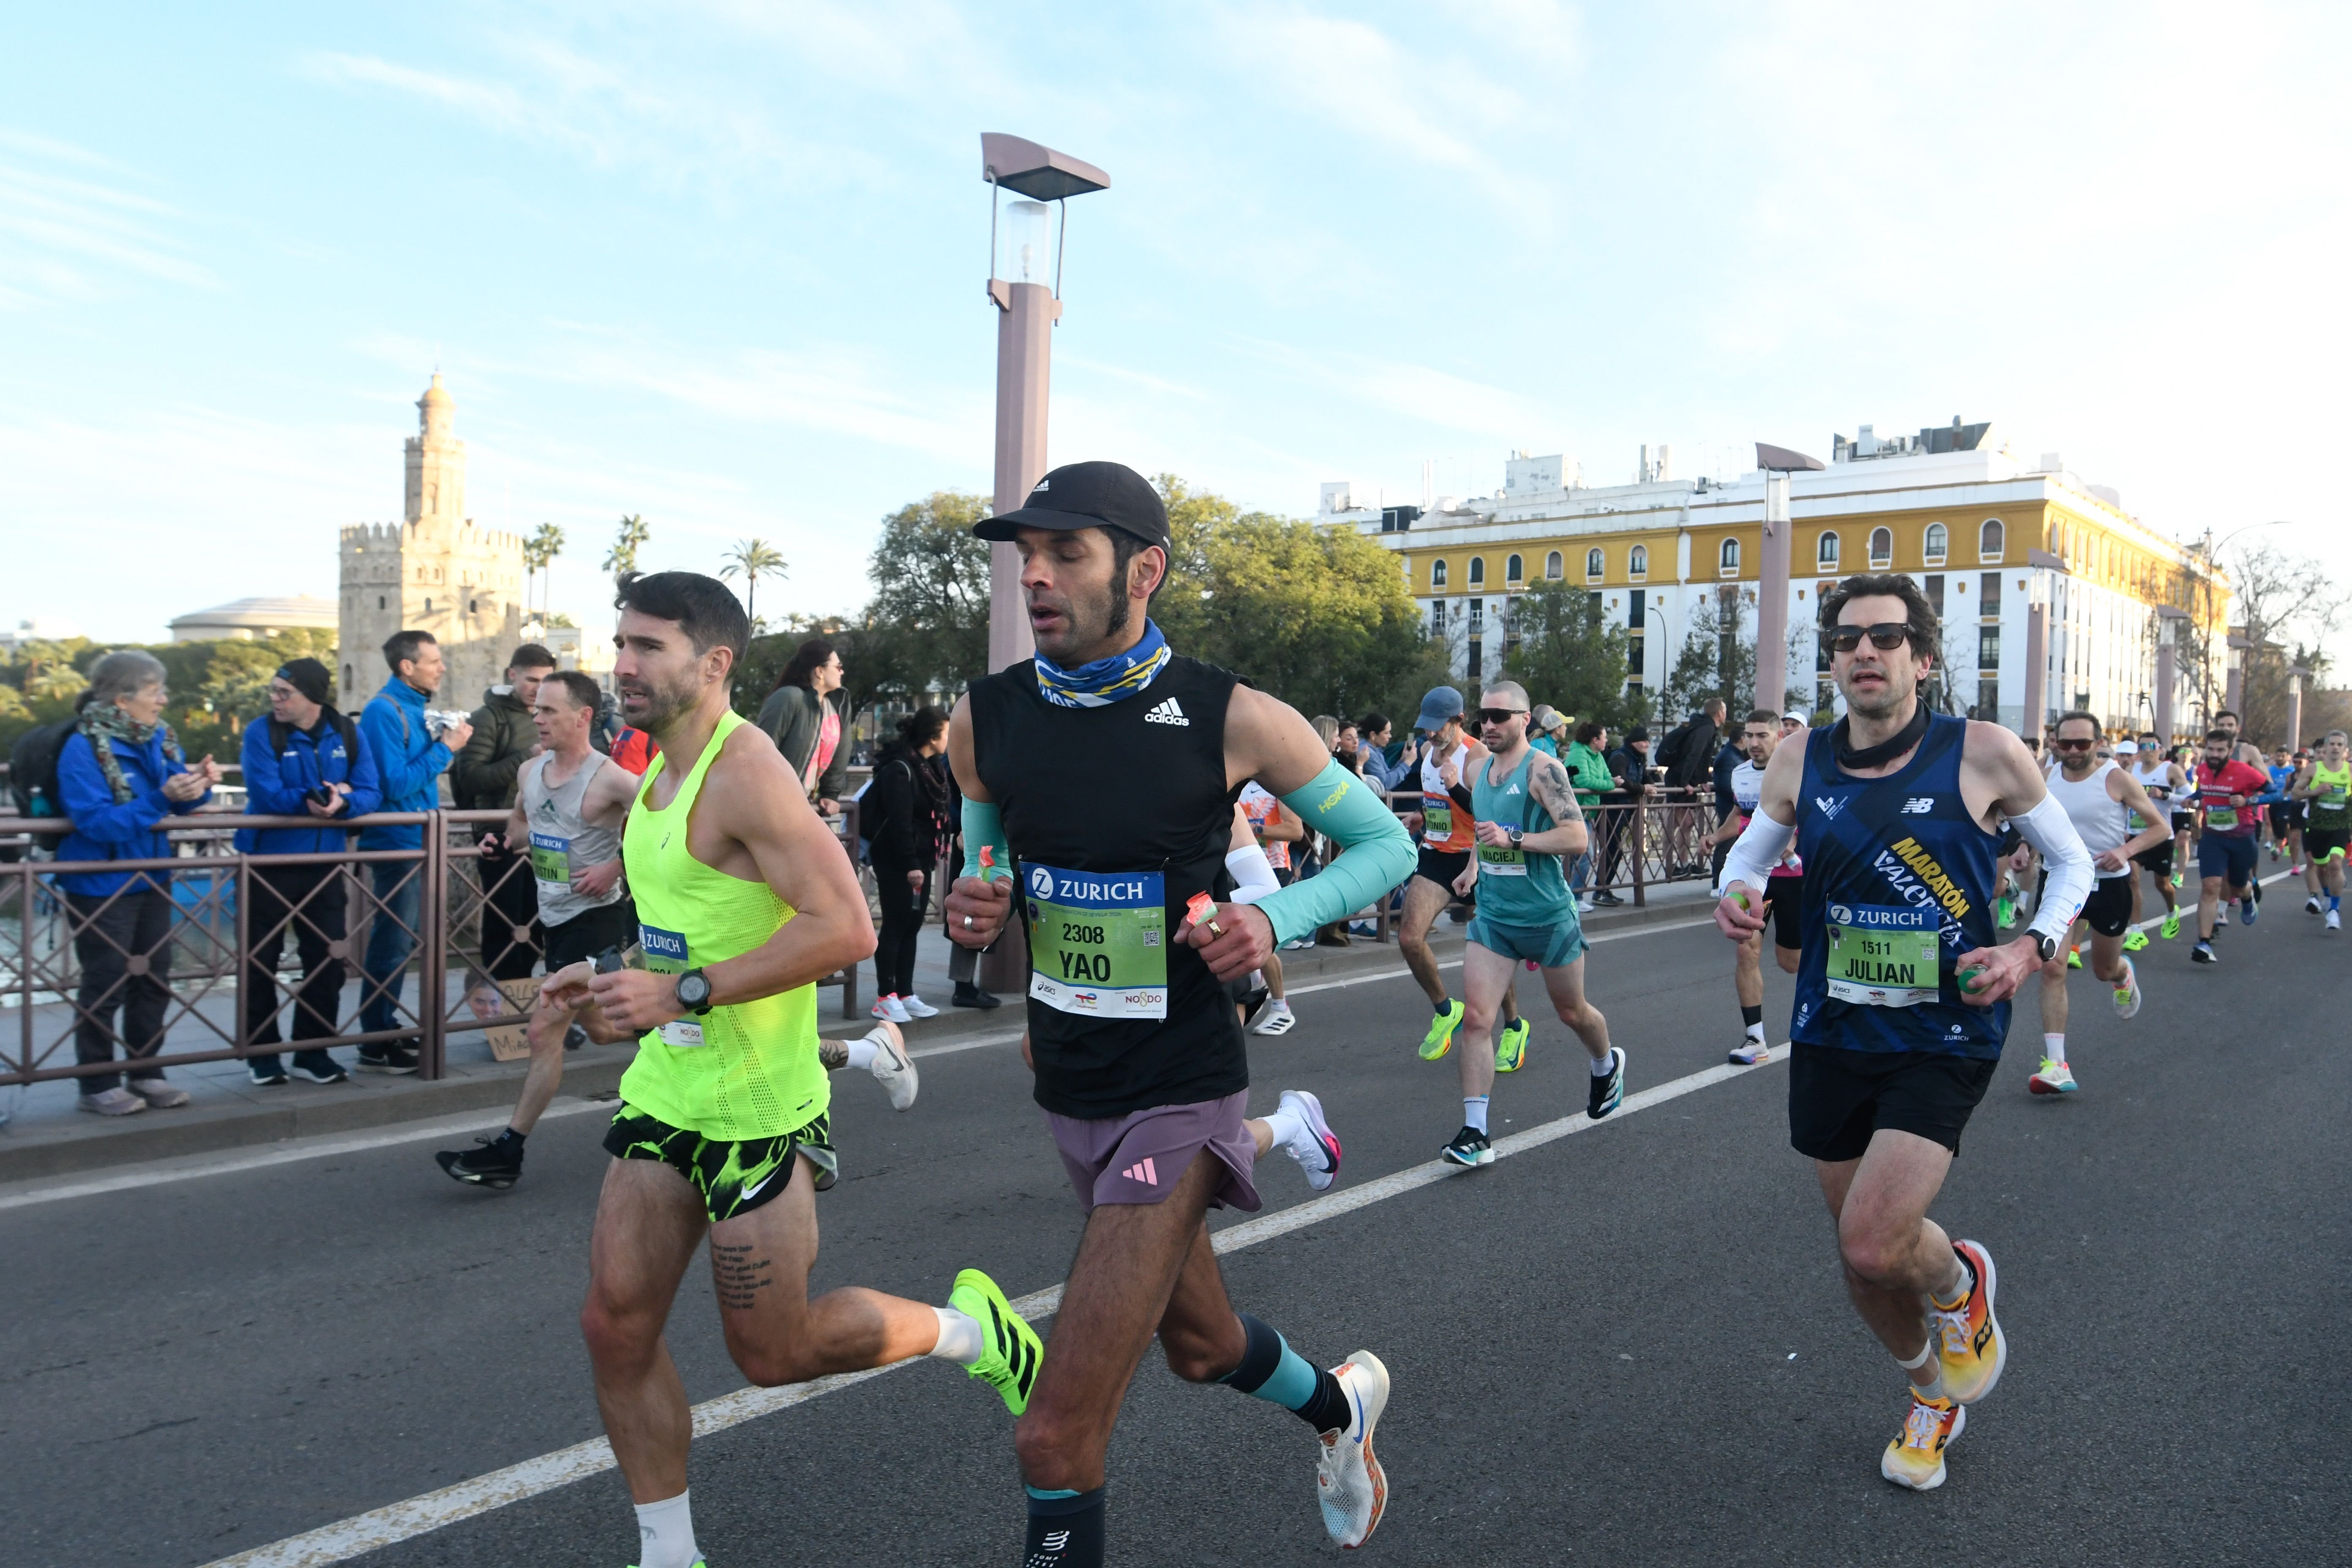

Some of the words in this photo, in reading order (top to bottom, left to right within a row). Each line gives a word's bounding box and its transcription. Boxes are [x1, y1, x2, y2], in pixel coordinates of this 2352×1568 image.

[1144, 713, 1189, 726] adidas
[1318, 780, 1350, 814] HOKA
[536, 837, 562, 849] ZURICH
[1482, 850, 1515, 862] MACIEJ
[1890, 836, 1970, 919] MARATÓN
[1060, 880, 1143, 900] ZURICH
[1858, 910, 1922, 925] ZURICH
[1063, 923, 1104, 944] 2308
[647, 934, 681, 953] ZURICH
[1862, 940, 1890, 955] 1511
[1059, 950, 1111, 982] YAO
[1845, 958, 1914, 984] JULIAN
[1043, 985, 1056, 995] asics
